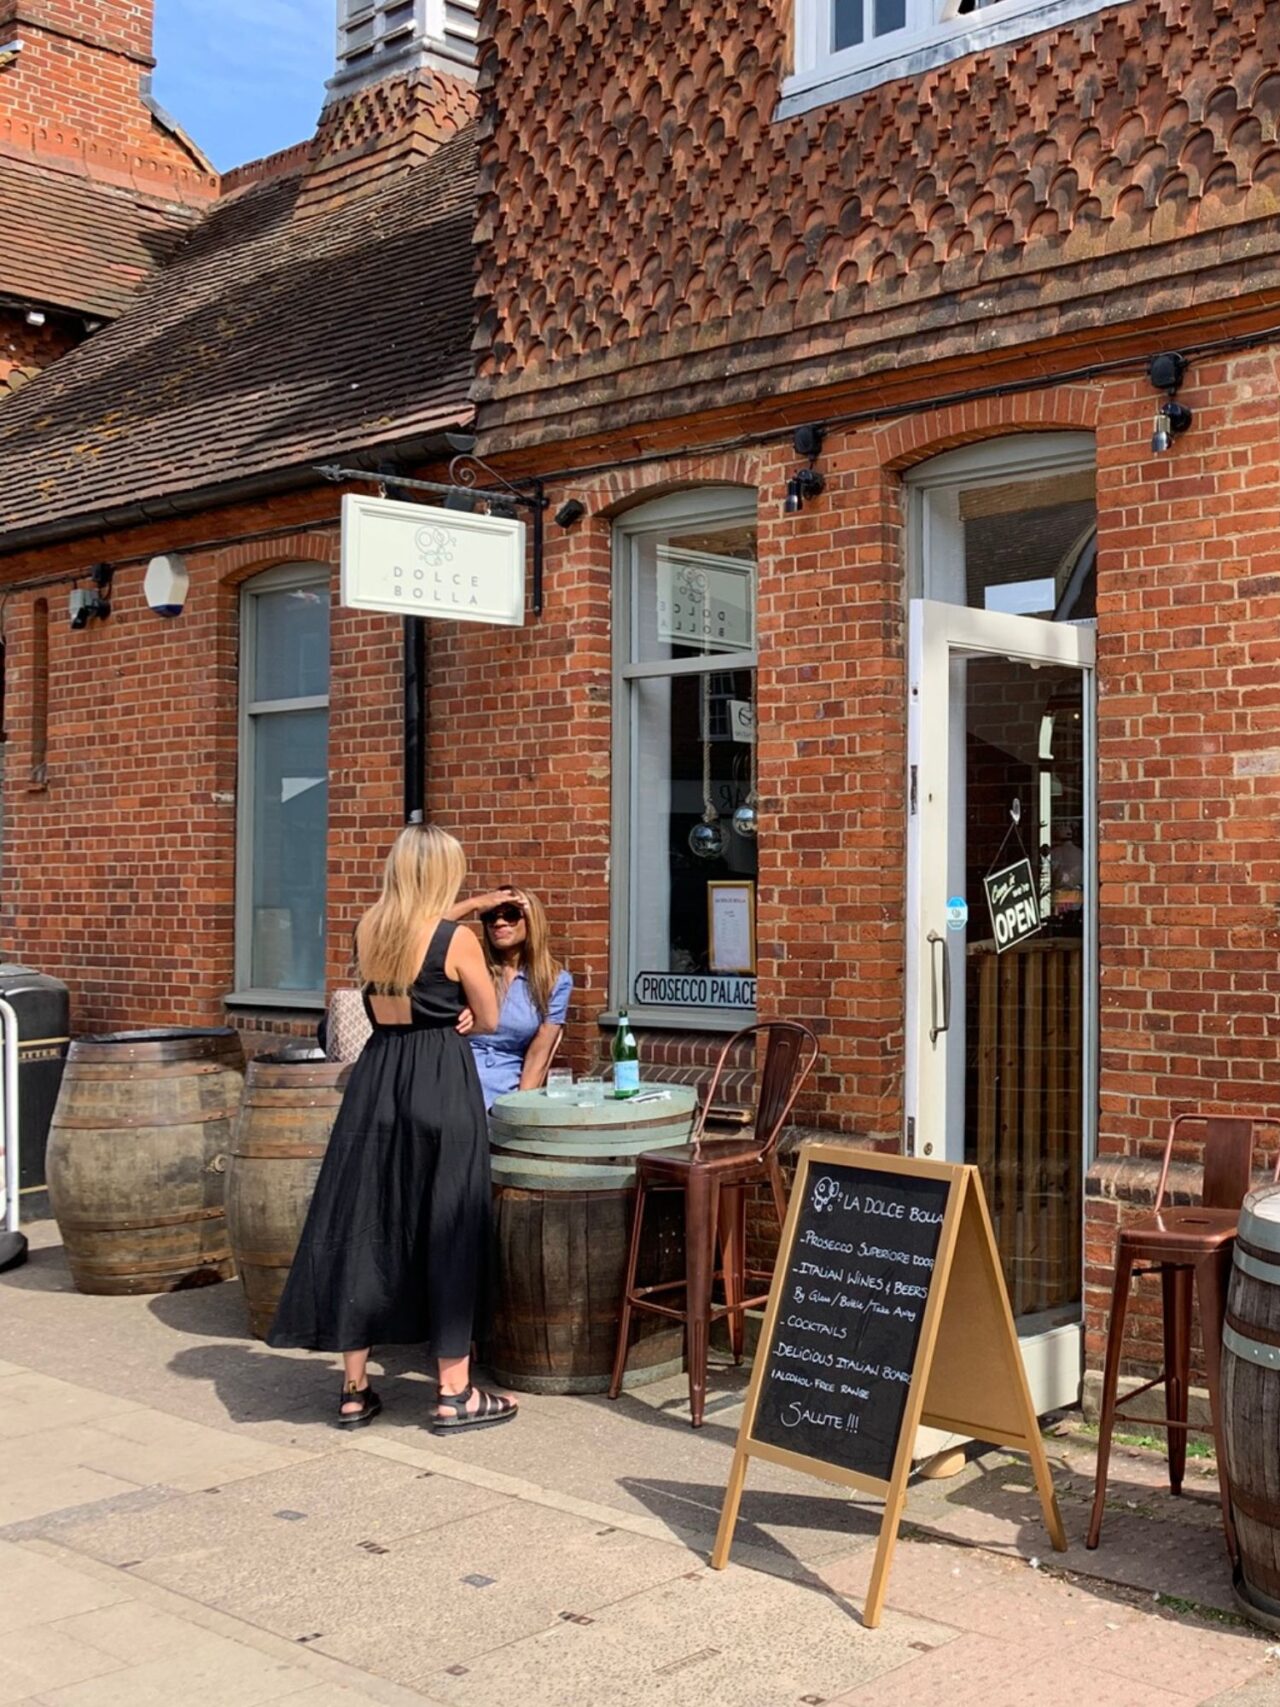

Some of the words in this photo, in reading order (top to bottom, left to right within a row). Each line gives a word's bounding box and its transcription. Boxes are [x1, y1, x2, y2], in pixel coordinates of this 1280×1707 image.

[393, 566, 479, 587] DOLCE
[393, 585, 478, 605] BOLLA
[995, 896, 1037, 944] OPEN
[642, 977, 707, 1002] PROSECCO
[711, 980, 757, 1005] PALACE
[843, 1193, 860, 1211] LA
[864, 1197, 906, 1219] DOLCE
[909, 1206, 944, 1225] BOLLA
[857, 1242, 910, 1265] SUPERIORE
[847, 1270, 884, 1291] WINES
[893, 1280, 929, 1299] BEERS
[793, 1285, 805, 1304] By
[892, 1308, 917, 1322] Away
[787, 1314, 848, 1340] COCKTAILS
[835, 1356, 881, 1377] ITALIAN
[780, 1401, 844, 1430] SALUTE
